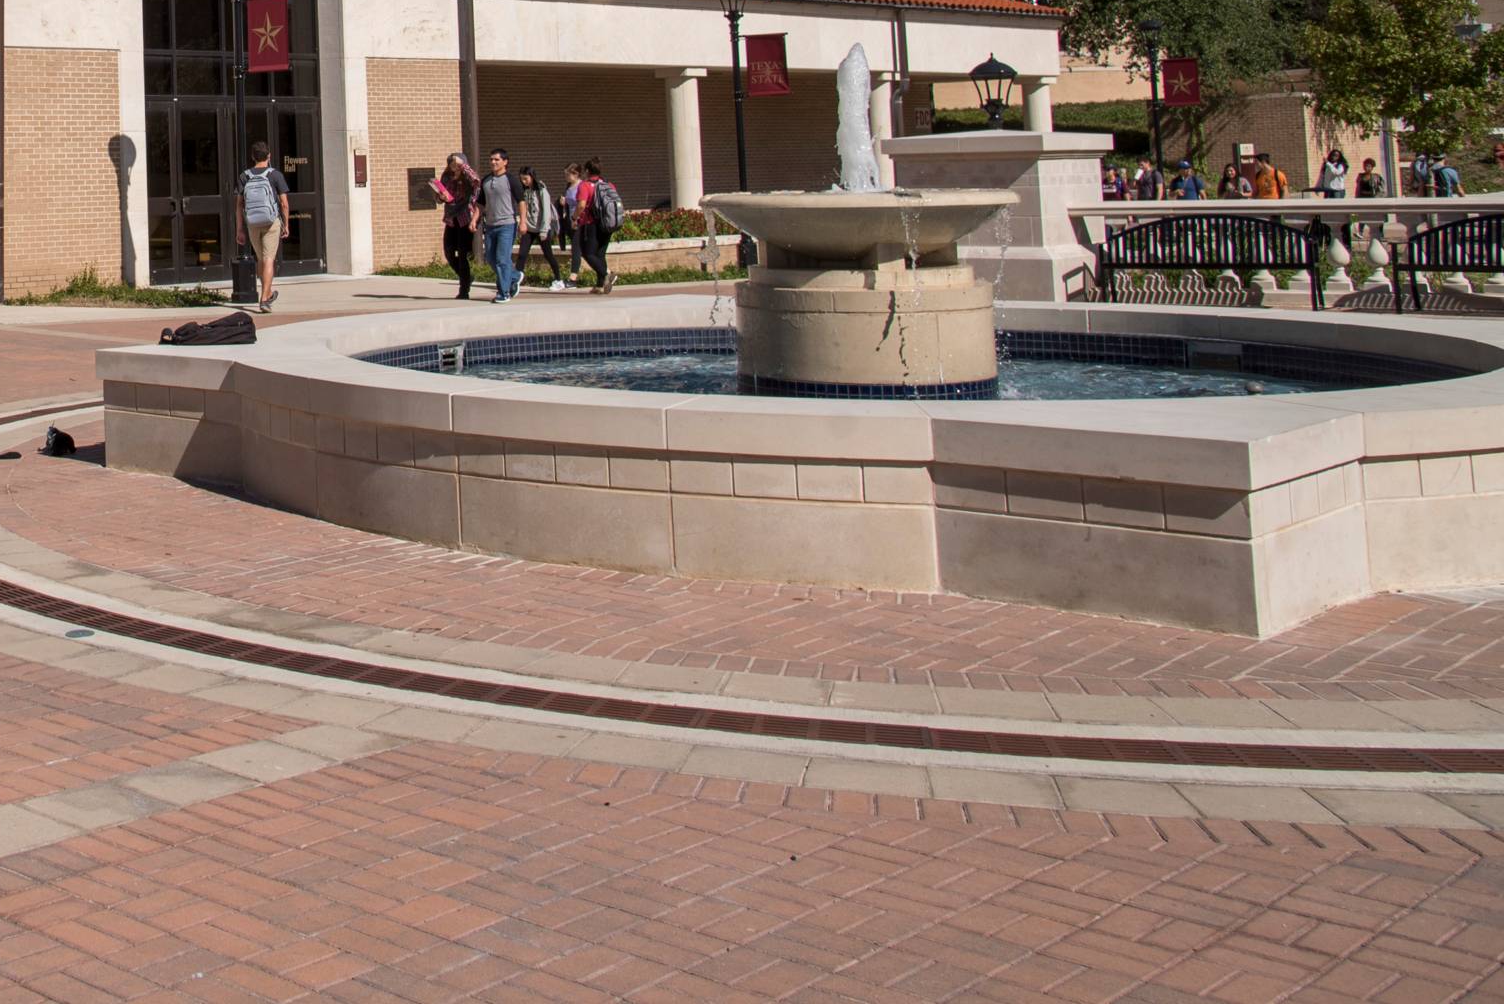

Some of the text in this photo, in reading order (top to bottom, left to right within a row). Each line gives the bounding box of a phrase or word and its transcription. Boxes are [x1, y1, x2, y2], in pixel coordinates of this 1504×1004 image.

[750, 61, 784, 70] TEXAS
[751, 74, 784, 84] STATE
[915, 110, 929, 125] FDC
[284, 156, 308, 164] Flowers
[284, 164, 296, 172] Hall
